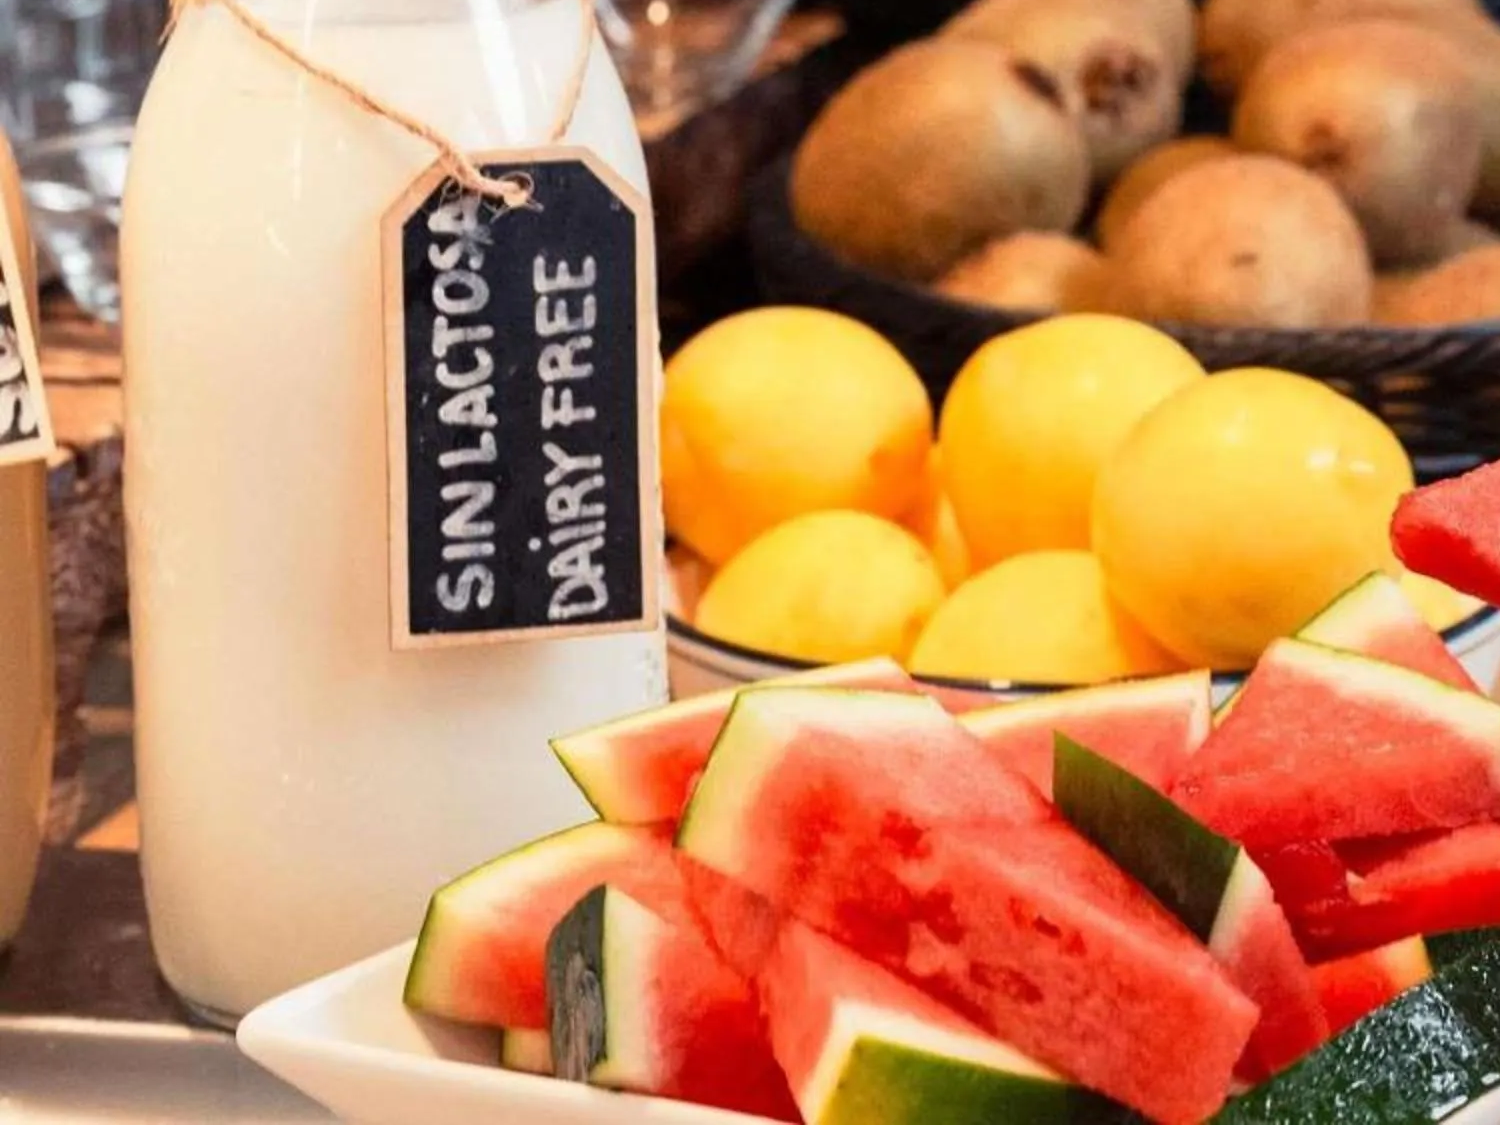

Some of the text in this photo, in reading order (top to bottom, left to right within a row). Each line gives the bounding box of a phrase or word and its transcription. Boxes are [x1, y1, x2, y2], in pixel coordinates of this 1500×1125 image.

[428, 192, 498, 613] SIN LACTOSA
[533, 254, 597, 430] FREE
